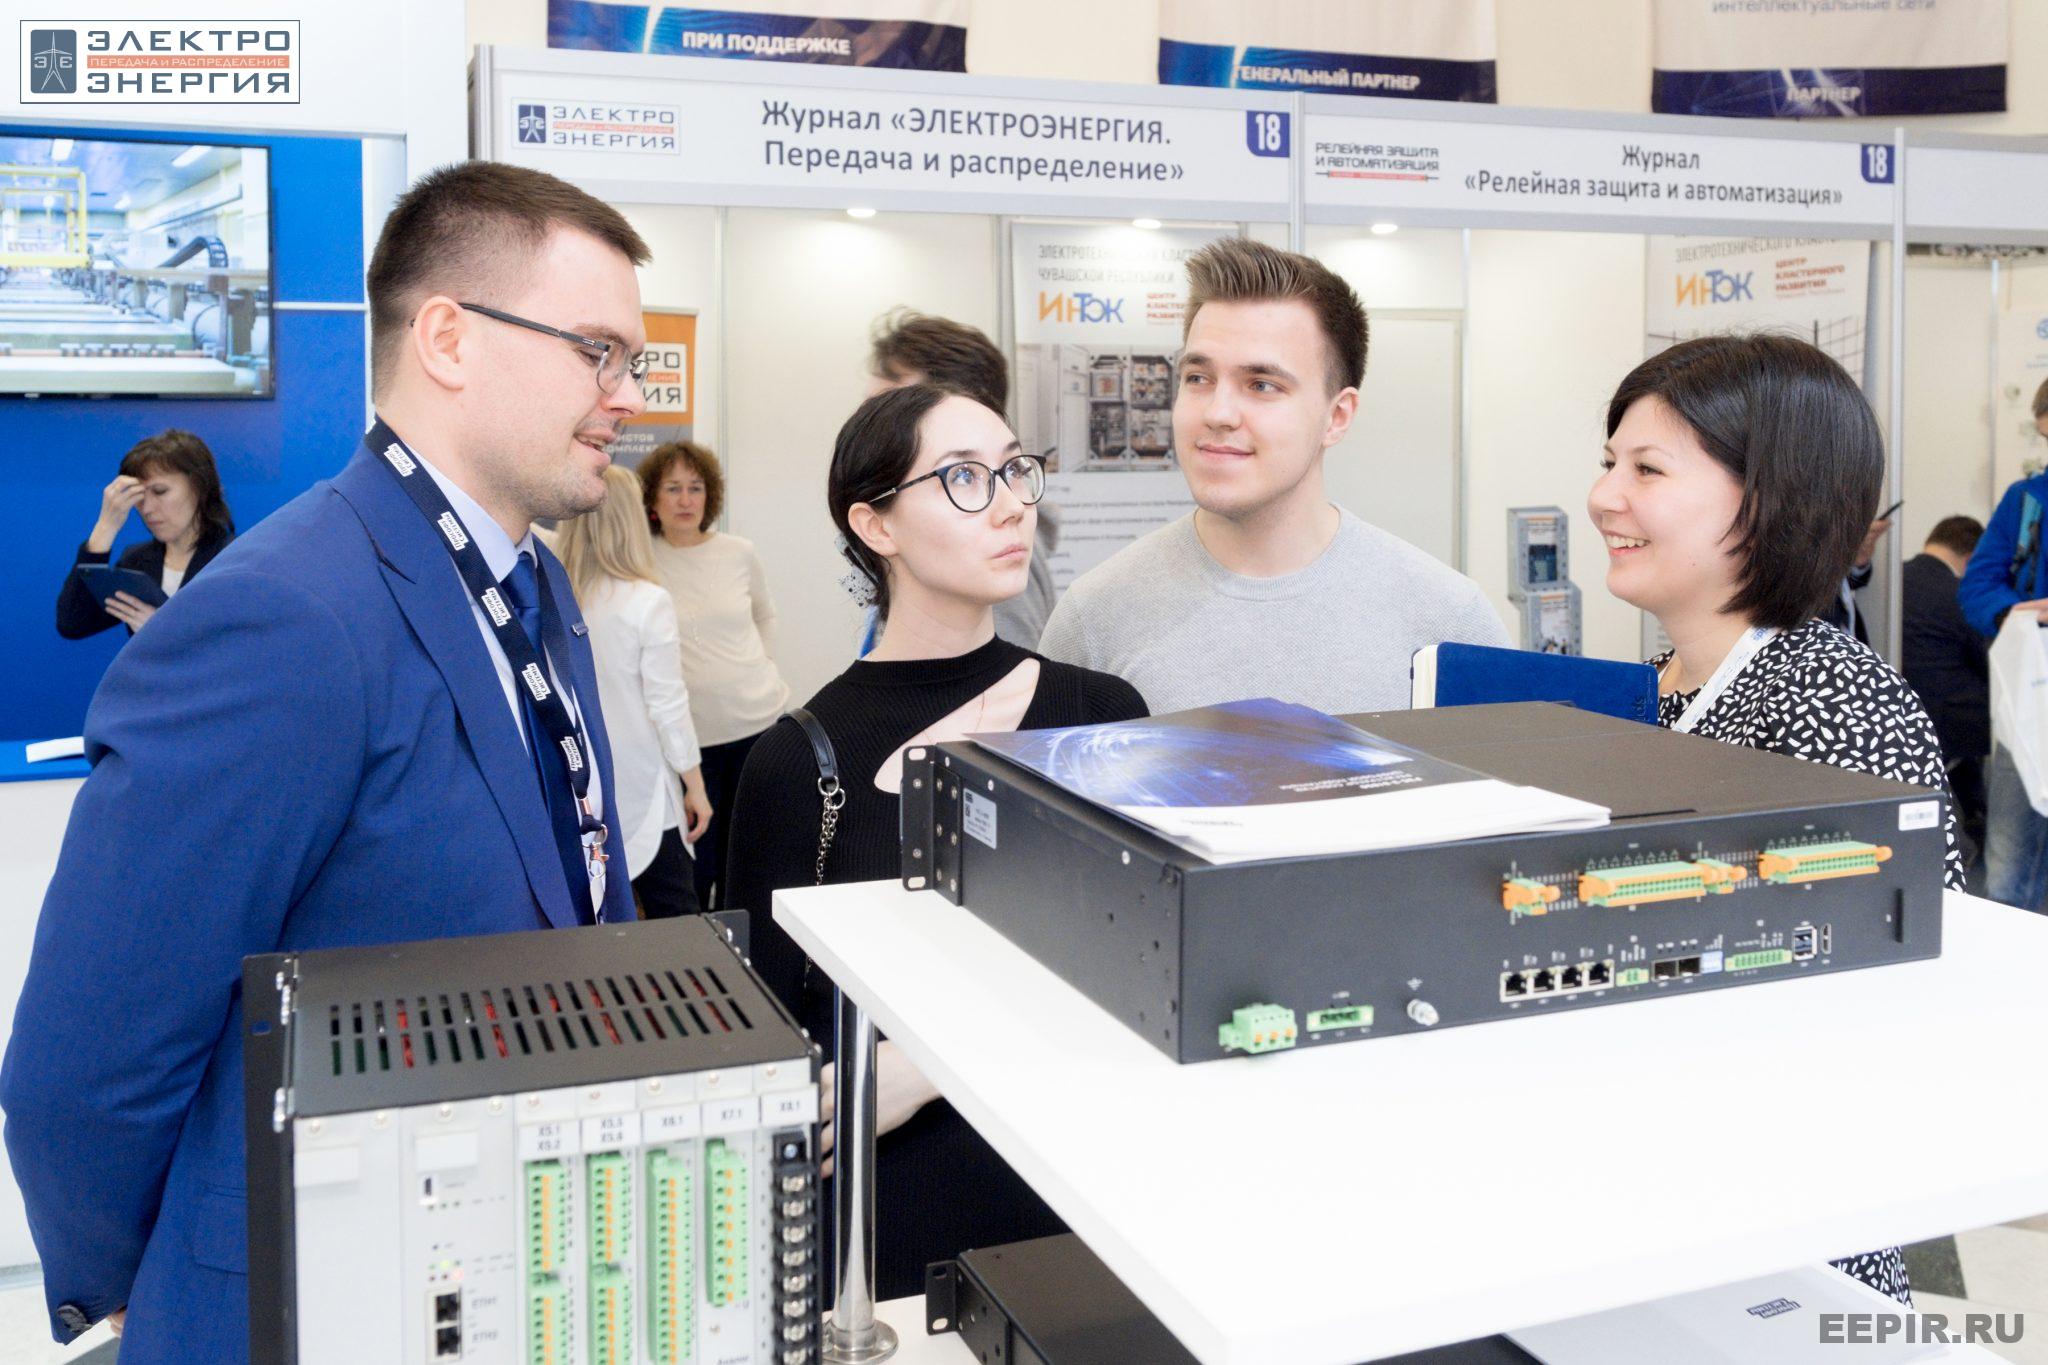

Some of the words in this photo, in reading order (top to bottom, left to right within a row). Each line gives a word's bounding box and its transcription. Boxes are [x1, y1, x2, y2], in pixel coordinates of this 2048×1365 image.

[682, 31, 723, 50] ПРИ
[728, 33, 851, 56] ПОДДЕРЖКЕ
[1233, 65, 1349, 88] ГЕНЕРАЛЬНЫЙ
[1352, 71, 1420, 91] ПАРТНЕР
[553, 106, 675, 124] ЭЛЕКТРО
[762, 100, 881, 134] Журнал
[891, 107, 1171, 145] «ЭЛЕКТРОЭНЕРГИЯ.
[553, 132, 675, 149] ЭНЕРГИЯ
[1255, 113, 1281, 152] 18
[765, 140, 913, 174] Передача
[924, 153, 940, 172] и
[951, 153, 1184, 182] распределение»
[1621, 145, 1700, 172] Журнал
[1866, 145, 1888, 180] 18
[1465, 170, 1581, 196] «Релейная
[1586, 179, 1661, 200] защита
[1667, 183, 1678, 199] и
[1685, 184, 1842, 208] автоматизация»
